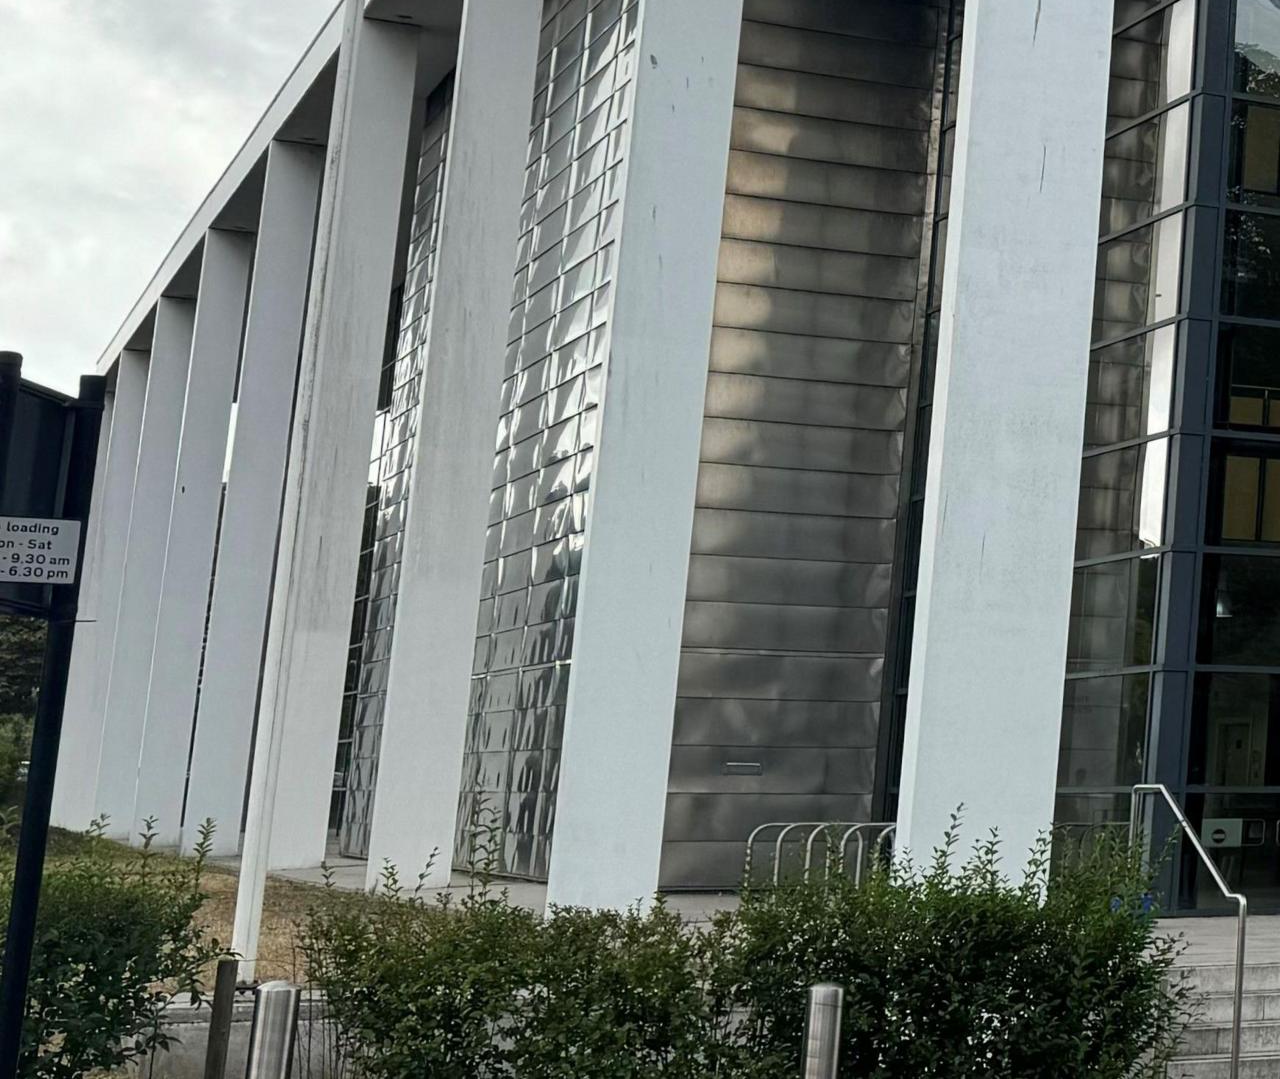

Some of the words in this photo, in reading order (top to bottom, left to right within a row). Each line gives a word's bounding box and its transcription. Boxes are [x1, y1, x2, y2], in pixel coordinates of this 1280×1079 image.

[6, 521, 59, 535] loading
[27, 539, 52, 550] Sat
[11, 553, 46, 564] 9.30
[49, 557, 70, 565] am
[9, 566, 43, 577] 6.30
[47, 570, 68, 580] pm
